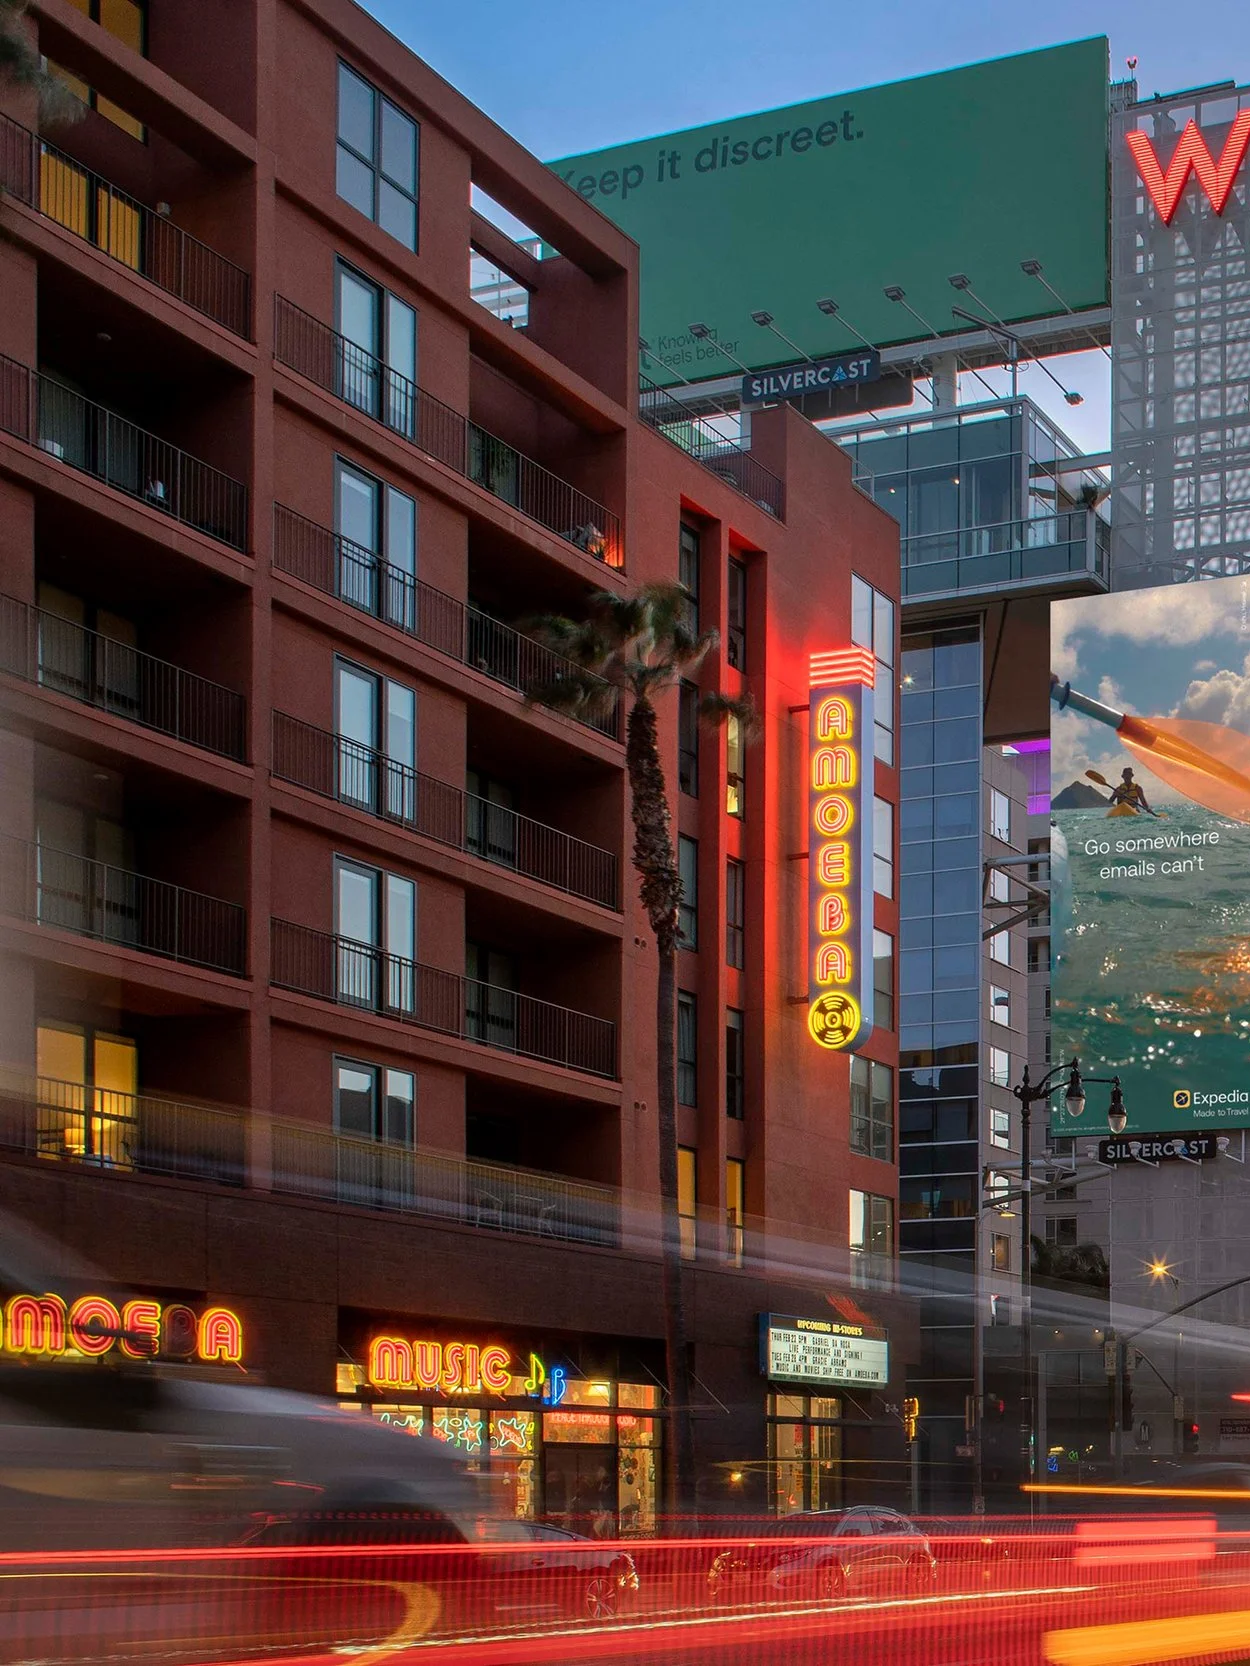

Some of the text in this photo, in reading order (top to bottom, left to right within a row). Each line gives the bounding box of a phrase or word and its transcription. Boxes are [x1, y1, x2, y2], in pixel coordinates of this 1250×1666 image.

[656, 151, 681, 182] it
[694, 110, 864, 174] discreet.
[658, 328, 718, 351] Knowg
[659, 349, 692, 367] feels
[751, 359, 871, 397] SILVERCAST
[813, 696, 855, 986] AMOEBA
[1085, 831, 1220, 856] Go somewhere
[1099, 855, 1204, 879] emails can't
[1193, 1090, 1249, 1107] Expedia
[1193, 1108, 1249, 1118] Made to Travel
[1106, 1139, 1209, 1159] SILERCST
[370, 1336, 512, 1391] MUSIC
